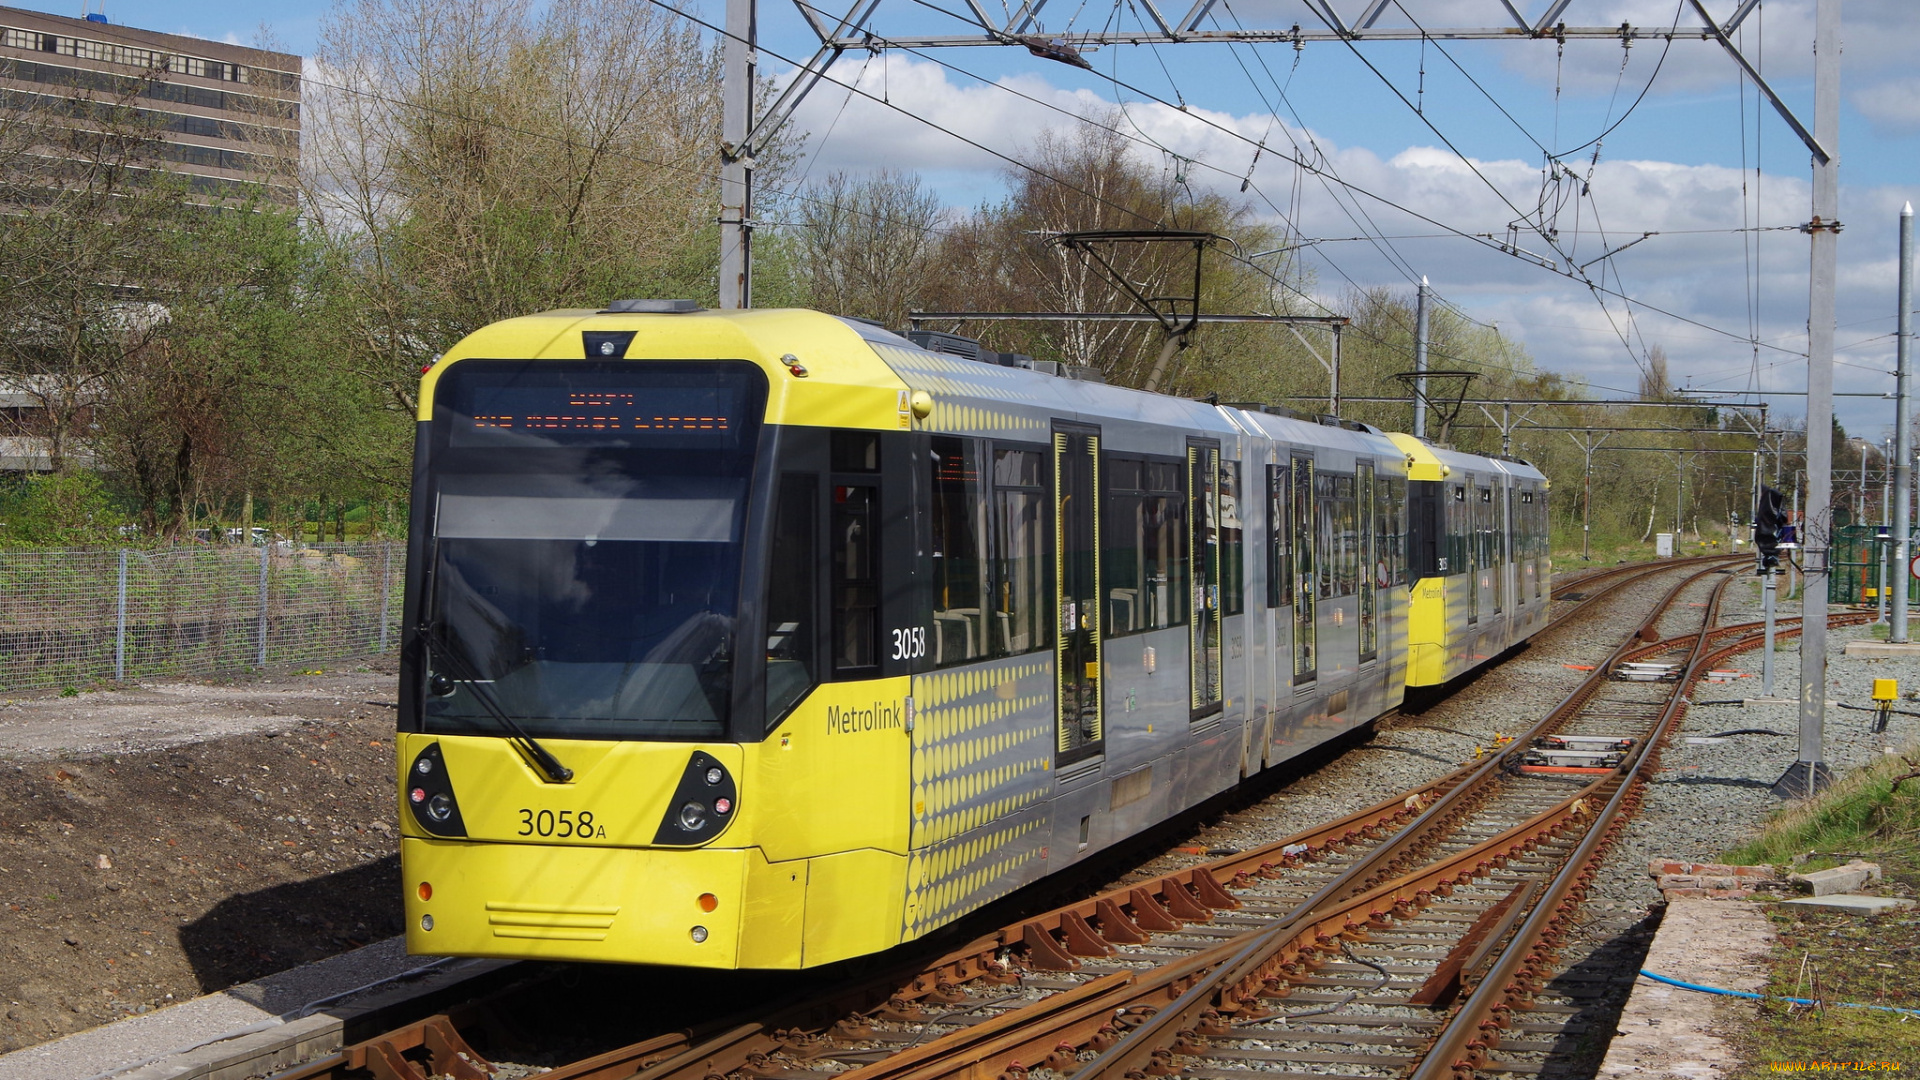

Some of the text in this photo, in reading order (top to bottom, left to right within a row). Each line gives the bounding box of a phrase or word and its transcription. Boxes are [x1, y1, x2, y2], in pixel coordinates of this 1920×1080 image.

[892, 626, 926, 660] 3058
[827, 700, 901, 735] Metrolink
[518, 808, 607, 839] 3058A
